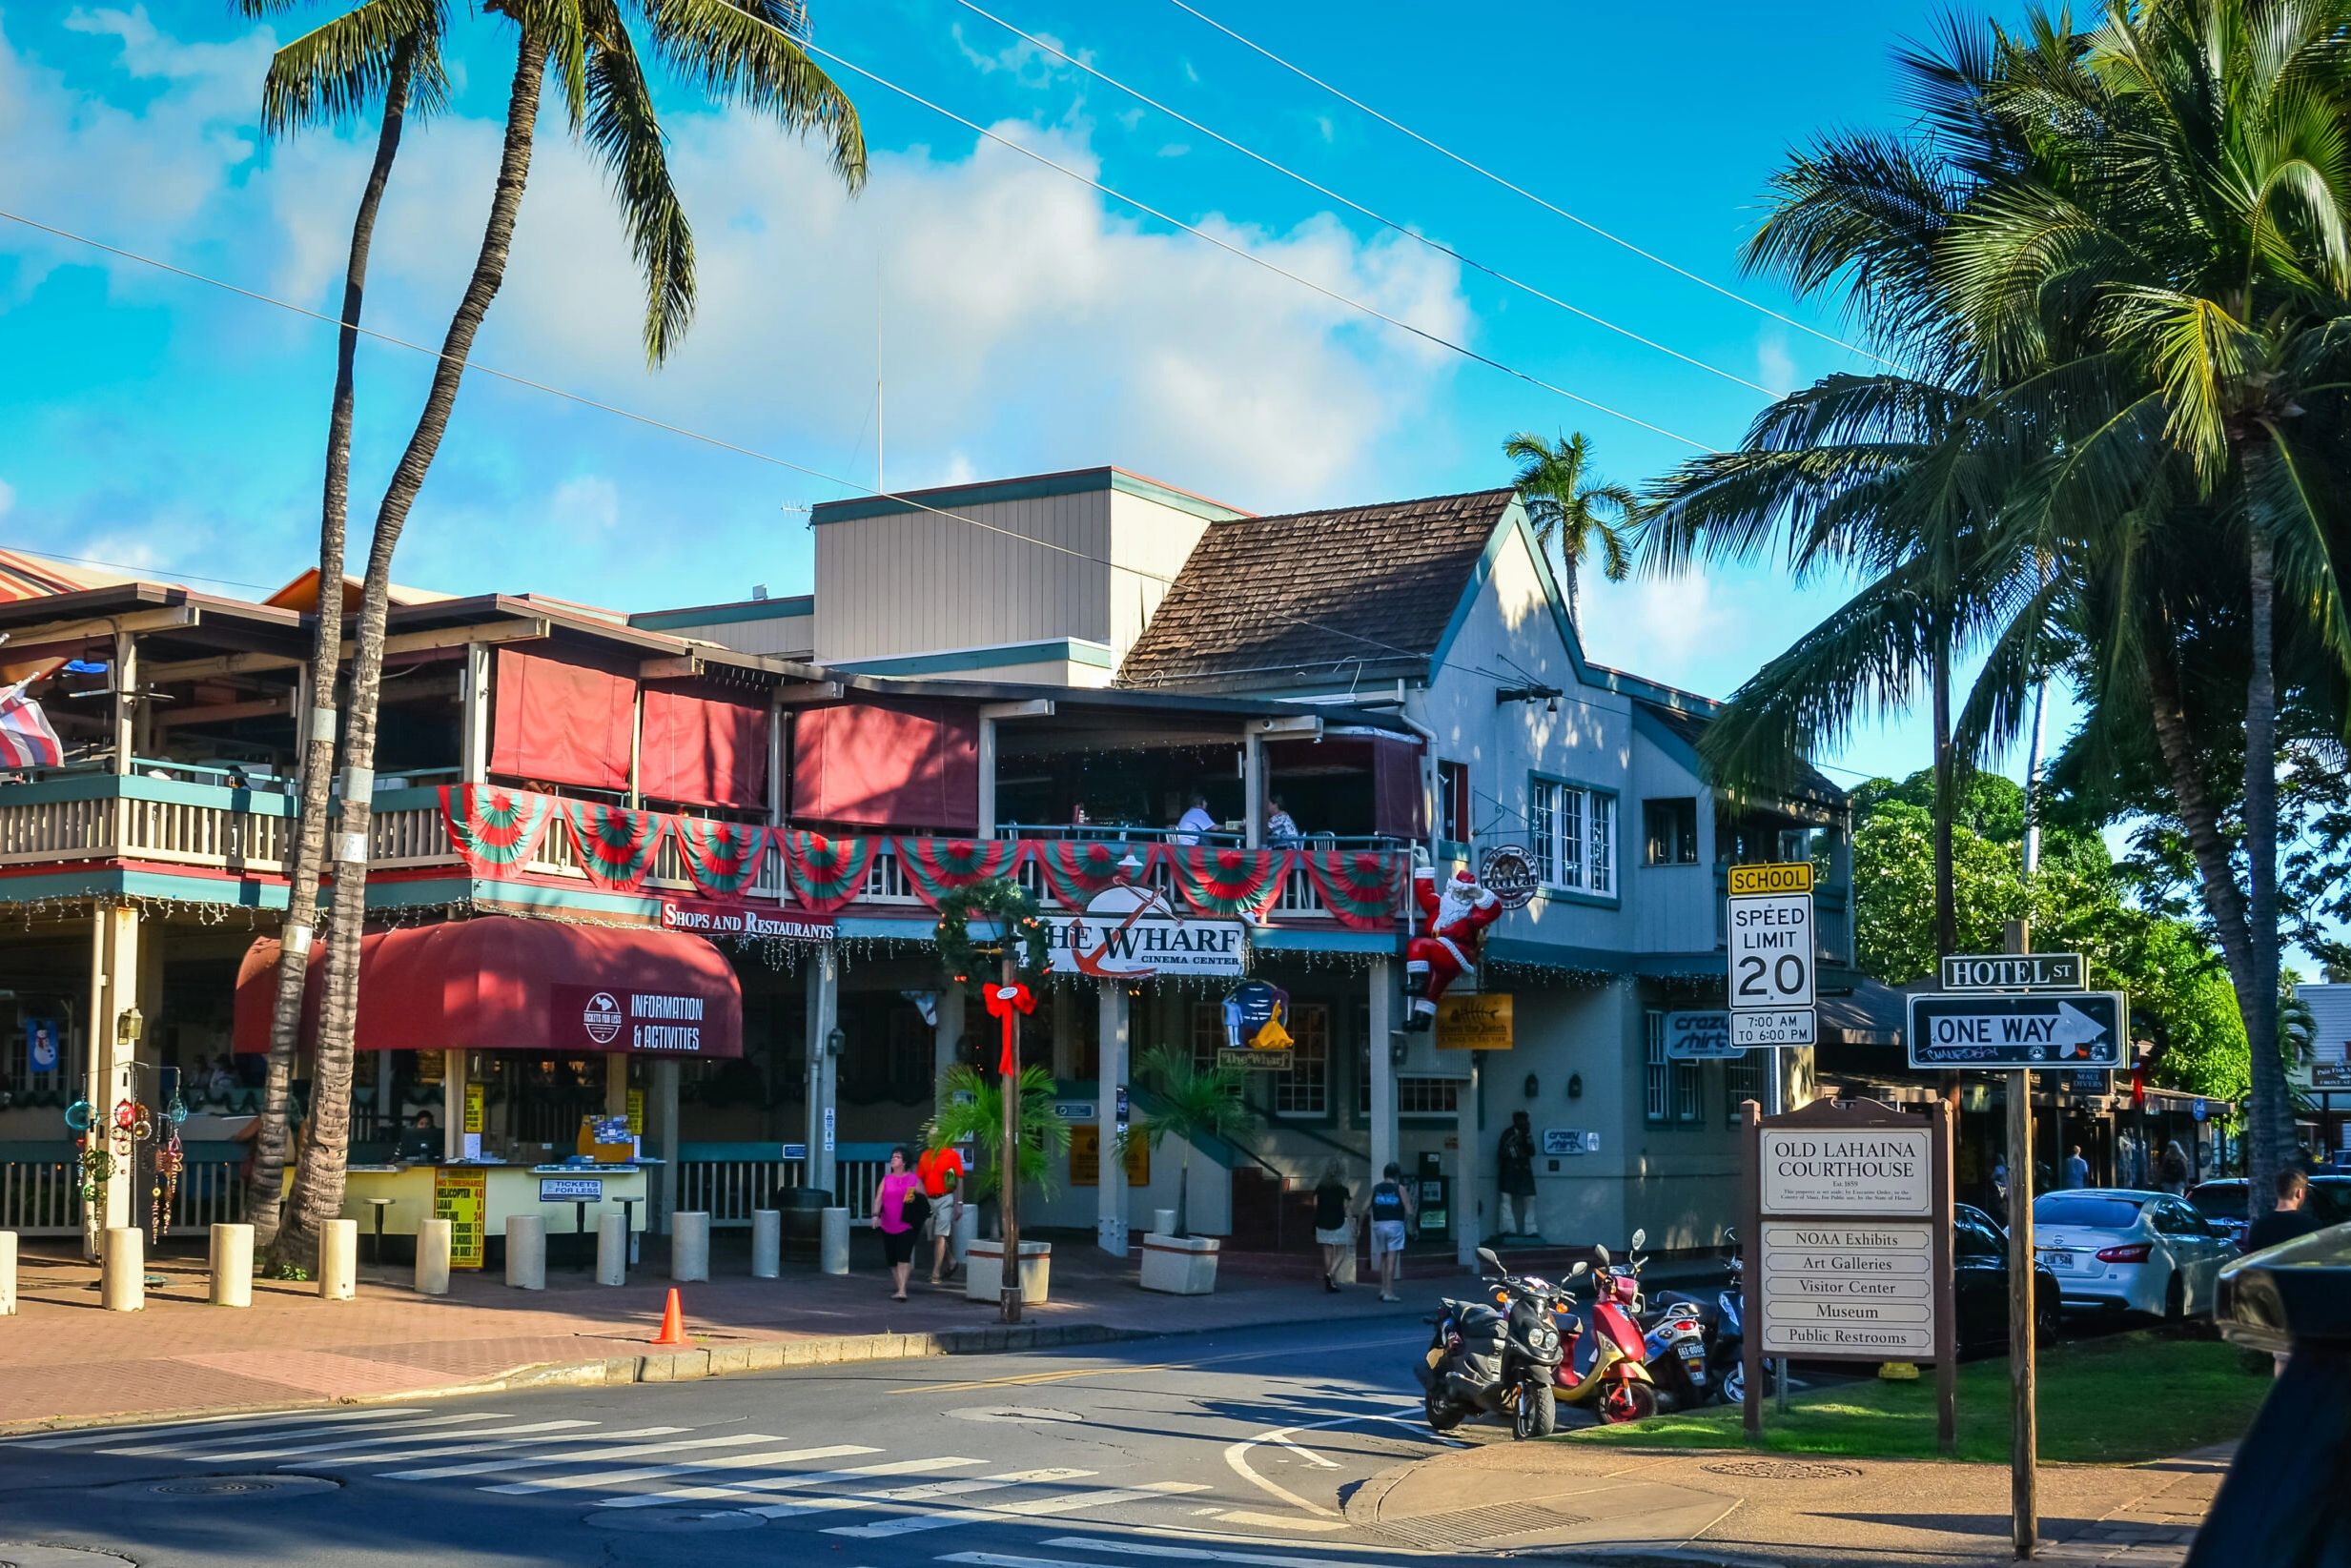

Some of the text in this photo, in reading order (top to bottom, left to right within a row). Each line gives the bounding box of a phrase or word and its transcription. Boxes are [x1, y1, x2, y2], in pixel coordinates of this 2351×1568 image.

[1734, 870, 1807, 889] SCHOOL
[664, 904, 834, 939] SHOPS AND RESTAURANTS
[1735, 907, 1805, 927] SPEED
[1049, 925, 1240, 960] HE WHARF
[1744, 931, 1797, 949] LIMIT
[1141, 955, 1239, 966] CINEMA CENTER
[1738, 954, 1805, 996] 20
[1951, 960, 2072, 986] HOTEL ST
[631, 994, 704, 1021] INFORMATION
[583, 1012, 622, 1025] TICKETS FOR LESS
[1748, 1015, 1797, 1028] 7:00 AM
[633, 1025, 700, 1050] & ACTIVITIES
[1739, 1029, 1808, 1041] TO 6:00 PM
[1937, 1017, 2058, 1043] ONE WAY
[1674, 1031, 1730, 1049] shirt
[2076, 1072, 2100, 1081] MAUI
[1775, 1142, 1916, 1158] OLD LAHAINA
[1778, 1162, 1914, 1177] COURTHOUSE
[437, 1188, 471, 1198] HELICOPTER
[437, 1200, 453, 1210] LUAU
[1796, 1232, 1899, 1246] NOAA Exhibits
[1803, 1256, 1892, 1271] Art Galleries
[1799, 1279, 1896, 1293] Visitor Center
[1816, 1304, 1879, 1318] Museum
[1789, 1328, 1907, 1344] Public Restrooms
